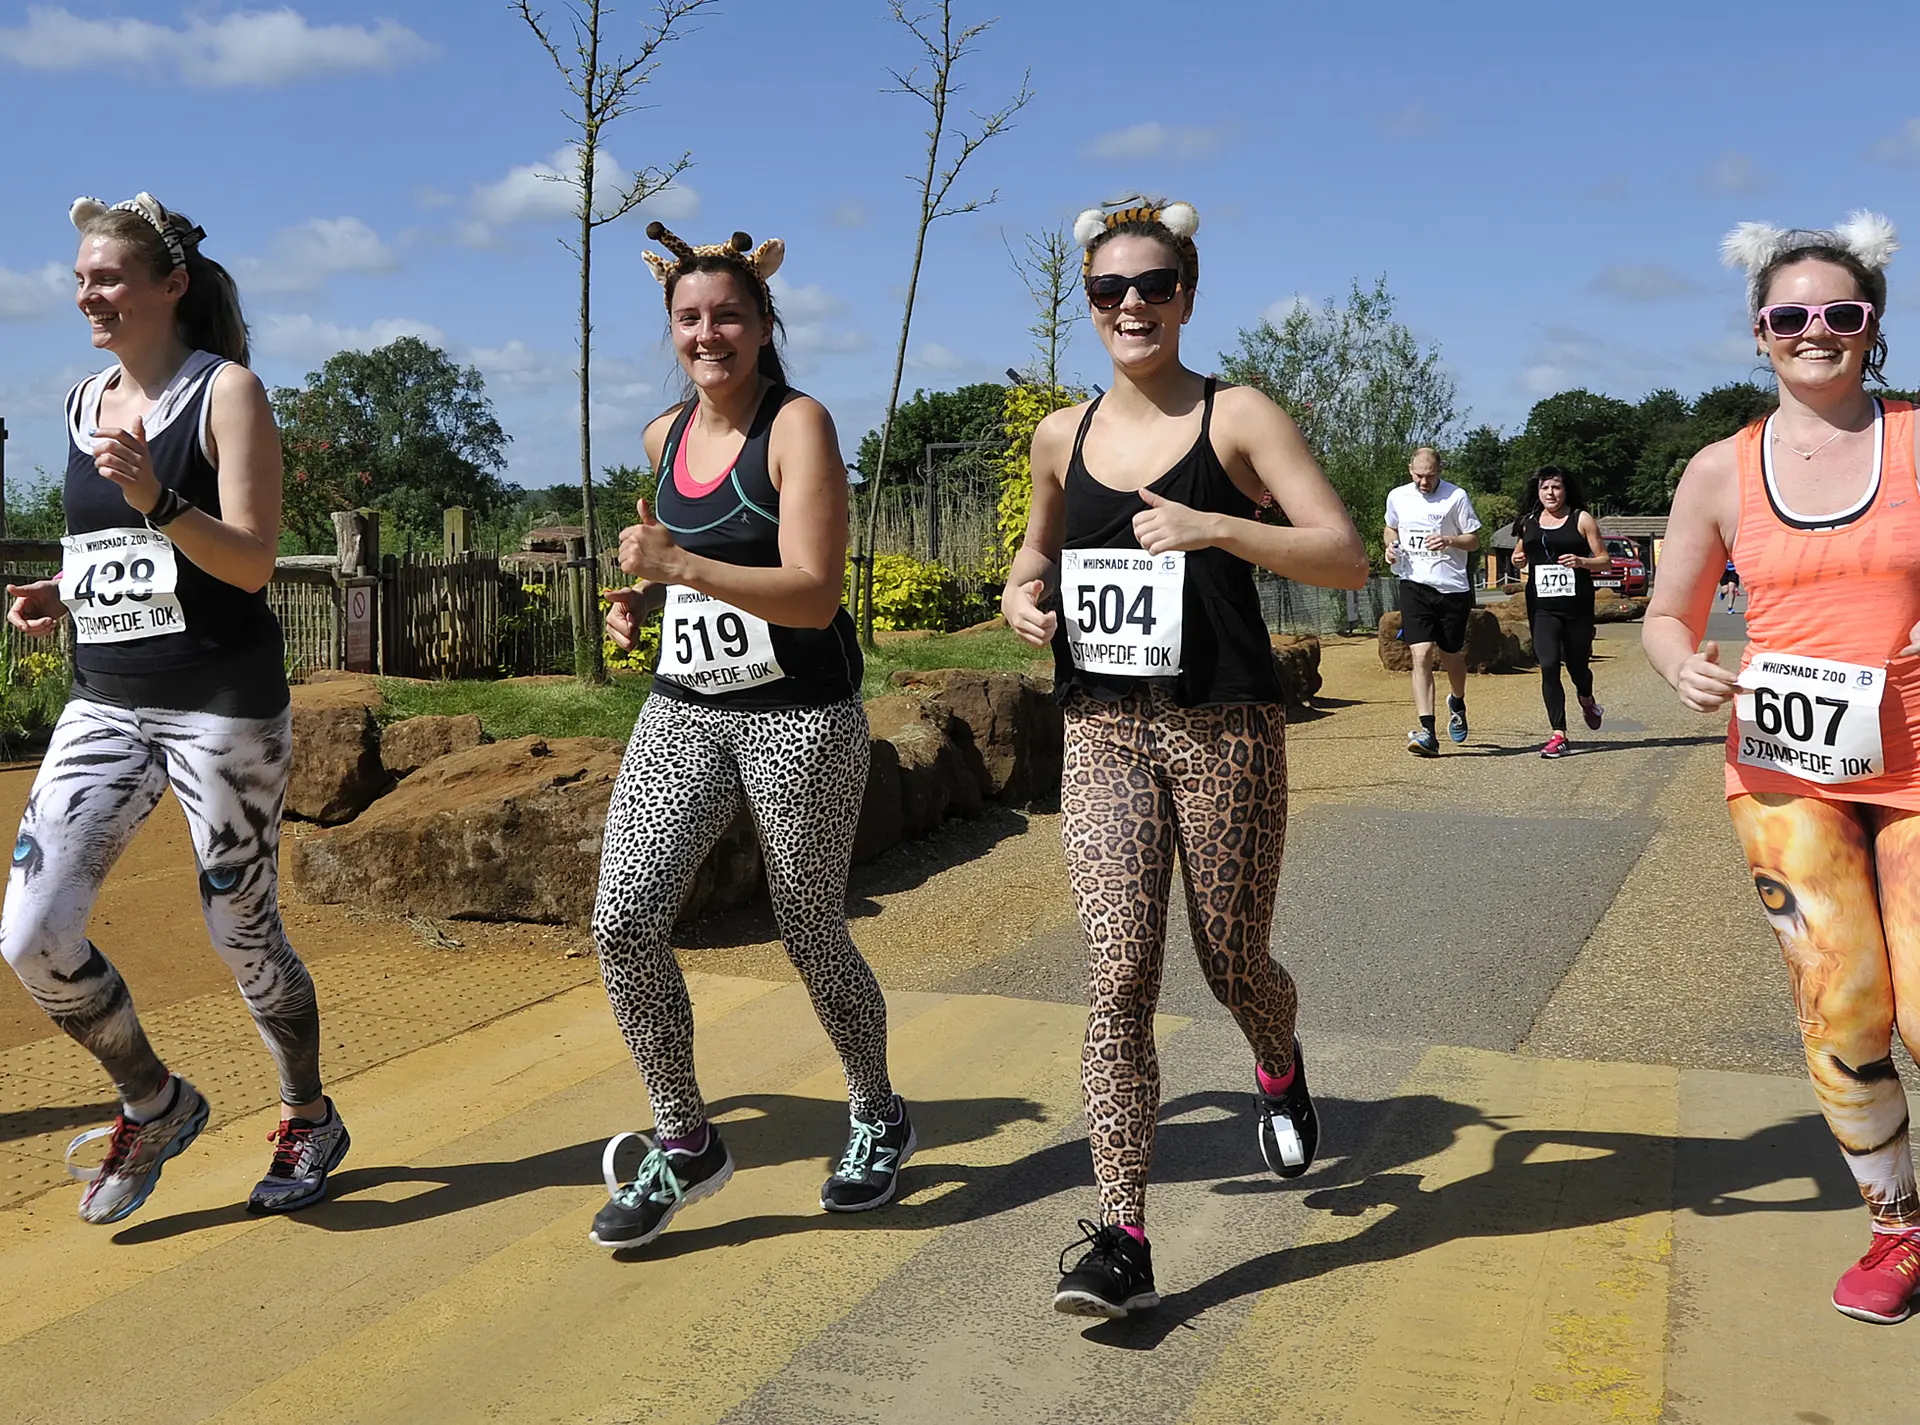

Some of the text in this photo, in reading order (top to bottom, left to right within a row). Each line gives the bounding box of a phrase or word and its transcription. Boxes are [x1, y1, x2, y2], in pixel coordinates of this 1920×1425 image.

[86, 535, 128, 553] WHIPSNADE
[131, 534, 148, 546] ZOO
[1083, 558, 1129, 570] WHIPSNADE
[1132, 559, 1153, 571] ZOO
[78, 606, 177, 639] STAMPEDE 10K
[1077, 584, 1157, 636] 504
[675, 612, 749, 664] 519
[1072, 641, 1172, 667] STAMPEDE 10K
[746, 661, 774, 681] 10K
[1762, 661, 1846, 684] WHIPSNADE ZOO
[1754, 686, 1849, 747] 607
[1743, 736, 1873, 776] STAMPEDE 10K
